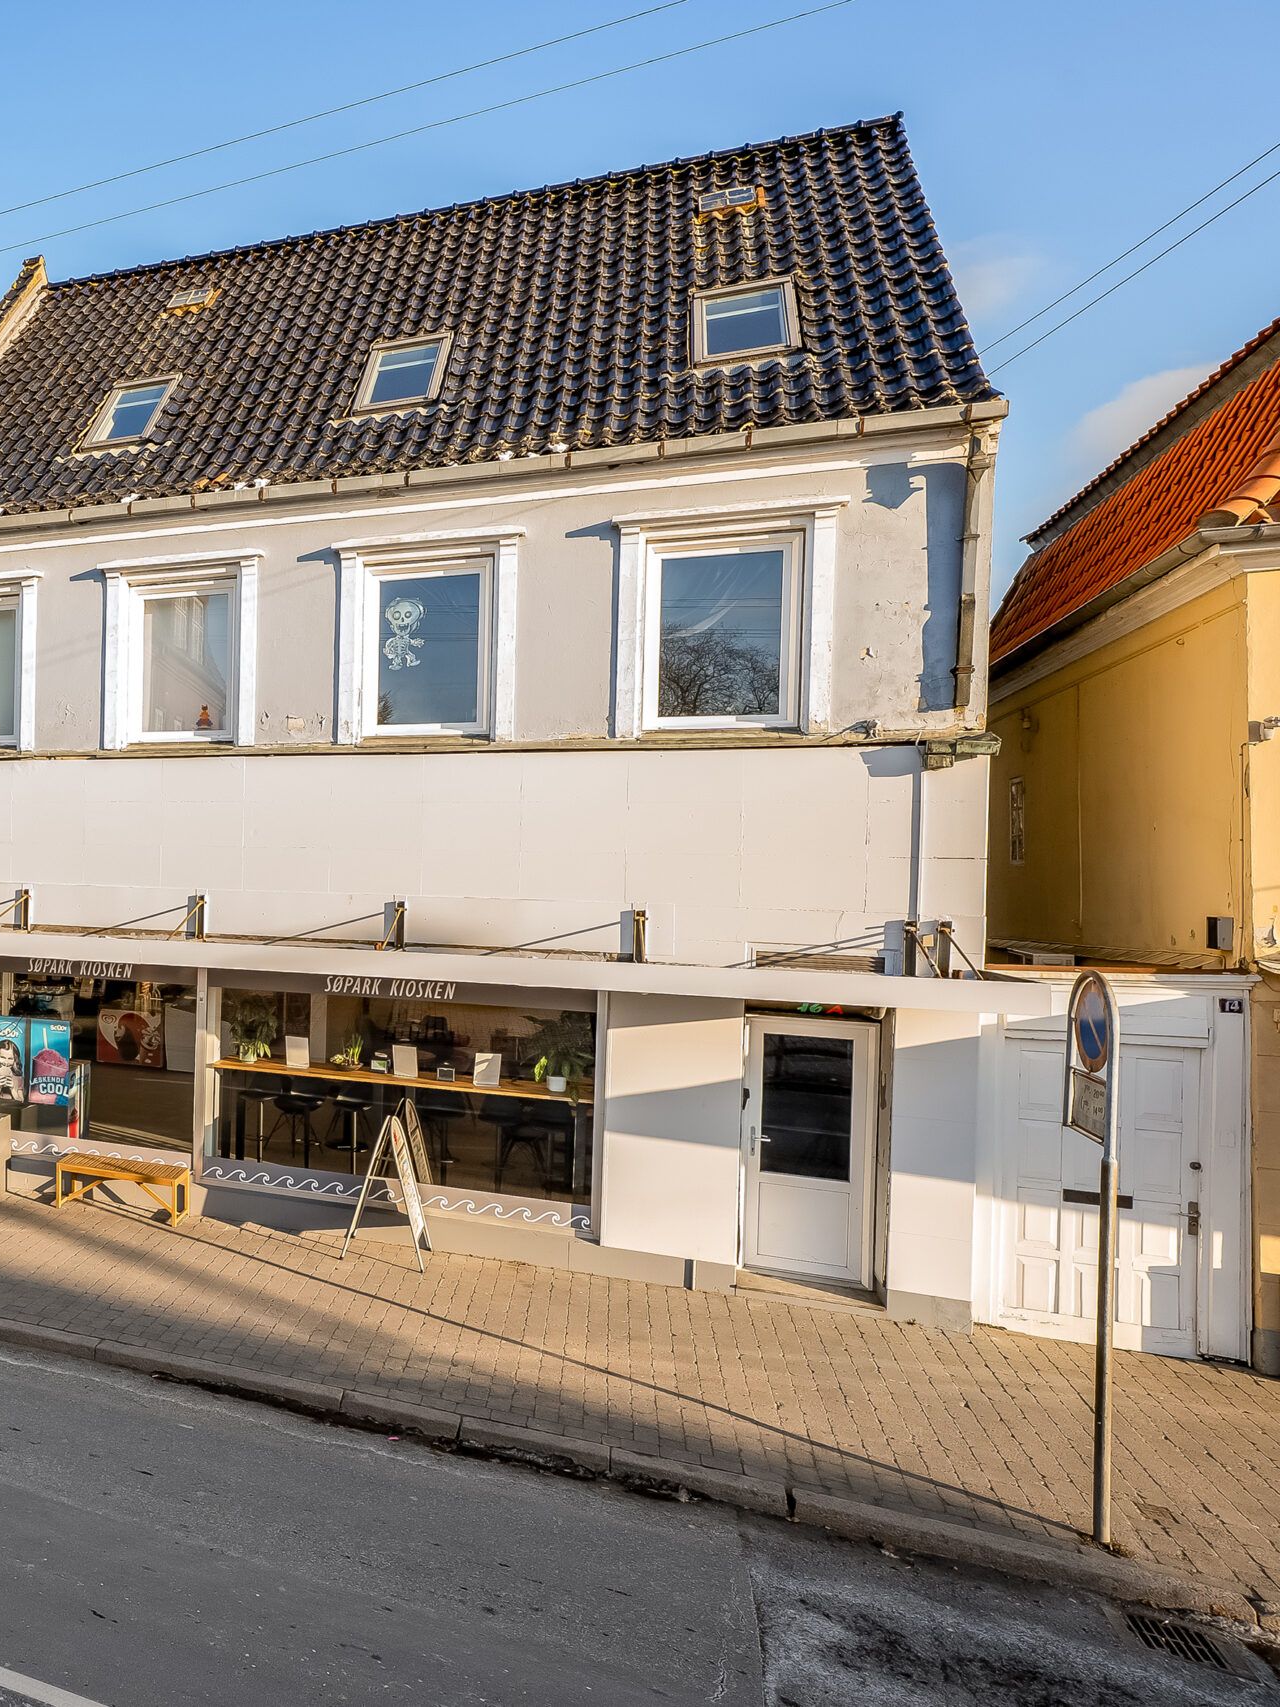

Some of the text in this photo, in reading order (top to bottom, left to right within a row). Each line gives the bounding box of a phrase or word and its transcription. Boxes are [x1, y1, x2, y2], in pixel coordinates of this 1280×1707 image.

[27, 958, 133, 979] SØPARK KIOSKEN
[324, 975, 456, 1000] SØPARK KIOSKEN
[797, 1002, 844, 1015] 16 A
[1225, 1000, 1240, 1012] 14
[39, 1083, 69, 1098] COOL
